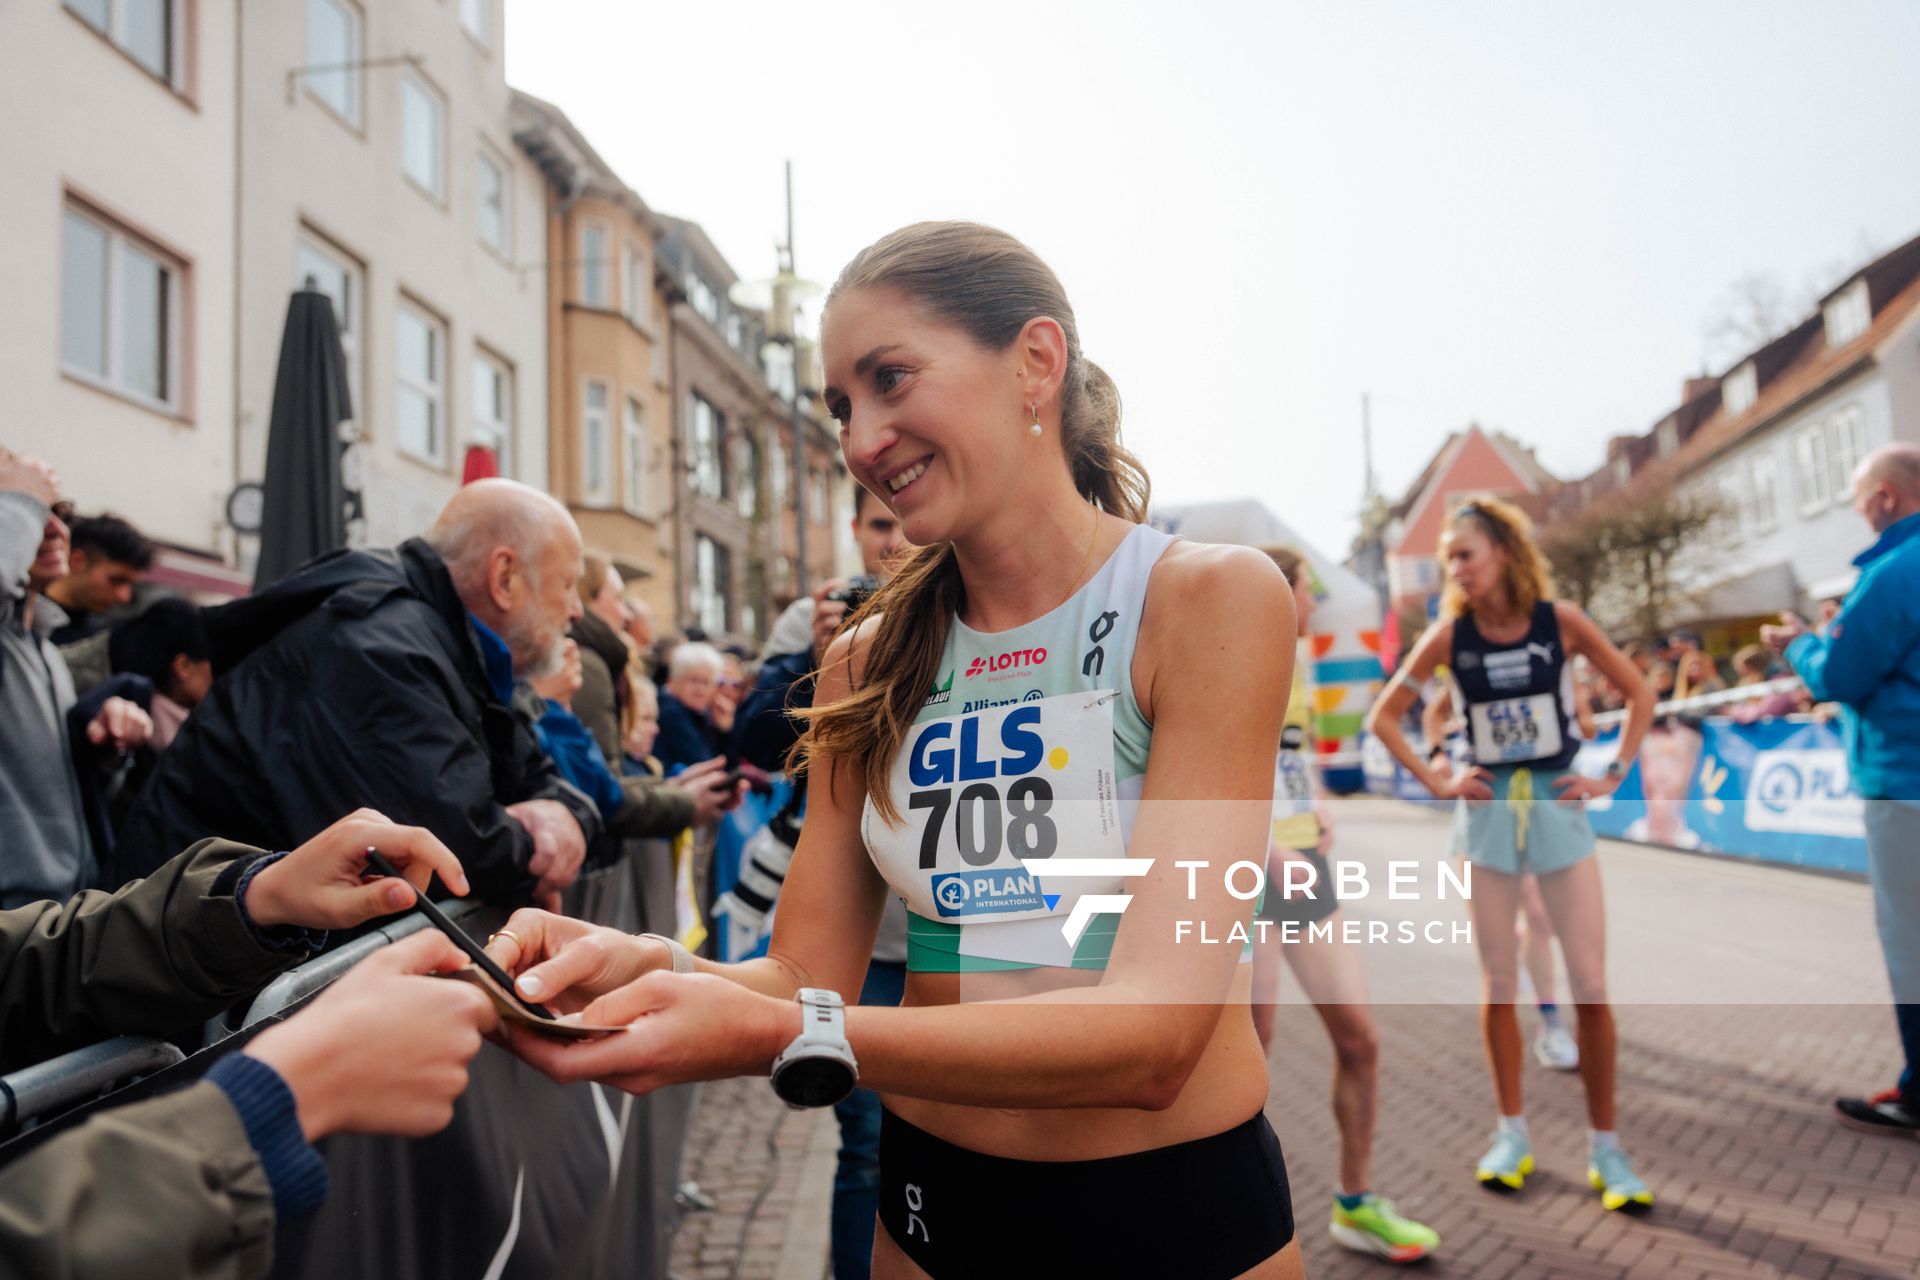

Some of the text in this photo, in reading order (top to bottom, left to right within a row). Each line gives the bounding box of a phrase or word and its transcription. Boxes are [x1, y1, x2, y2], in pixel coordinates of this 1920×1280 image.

[988, 647, 1047, 672] LOTTO
[909, 776, 1057, 870] 708
[973, 876, 1036, 898] PLAN
[976, 898, 1038, 908] INTERNATIONAL
